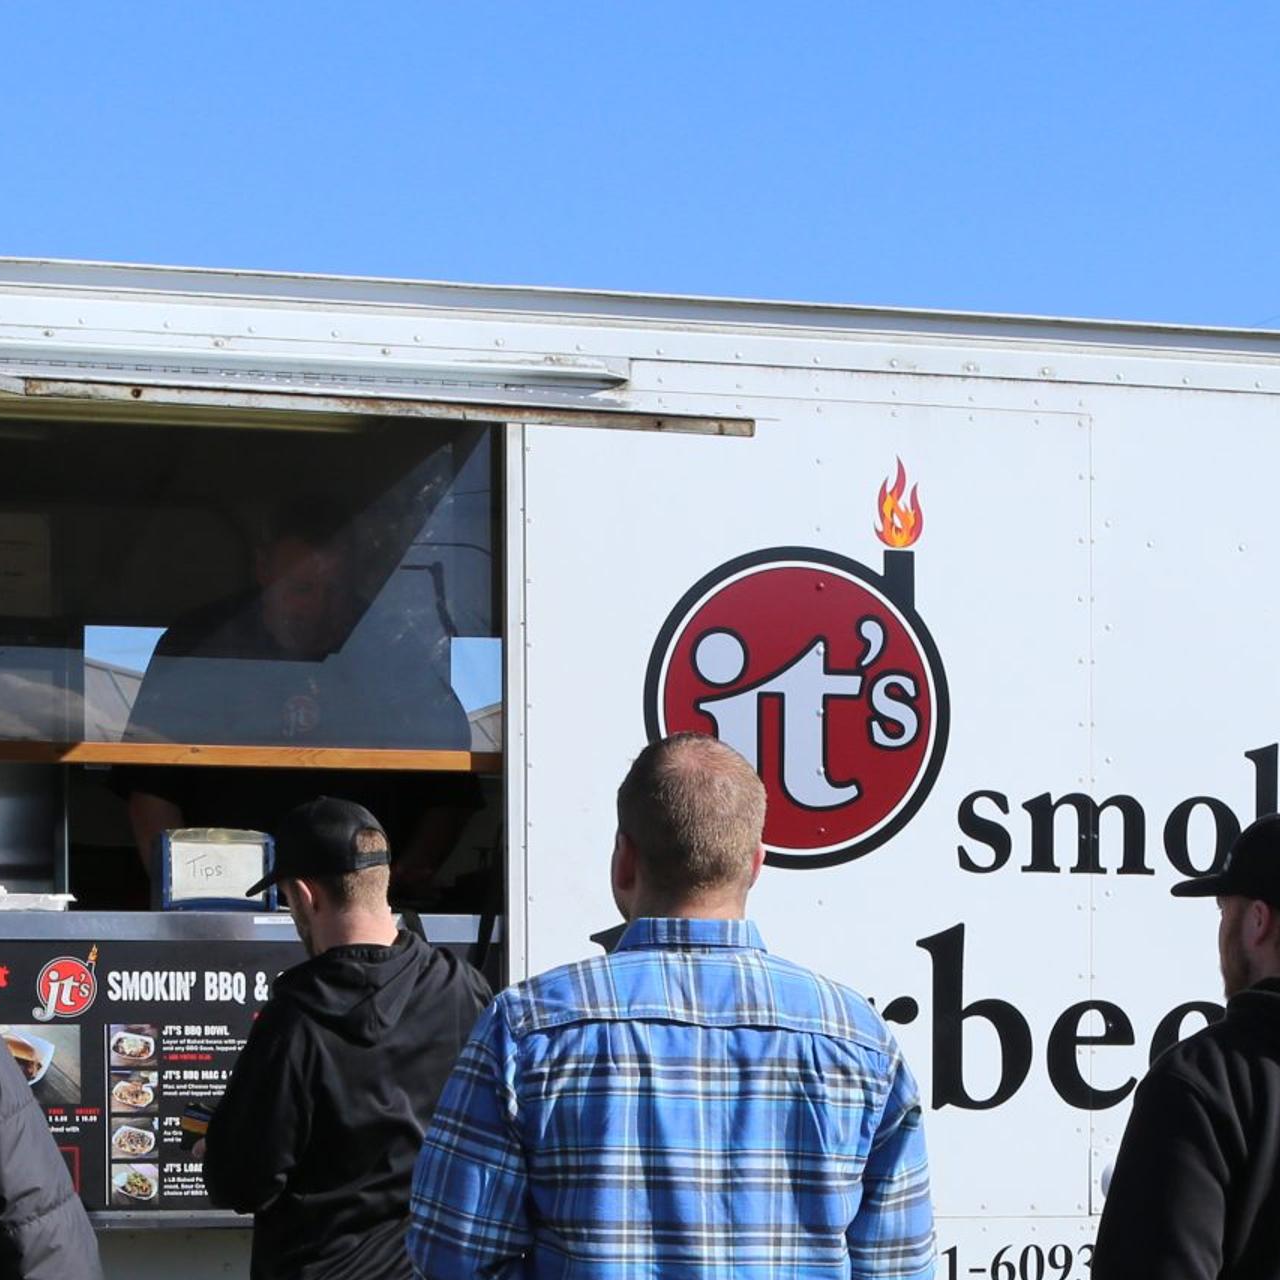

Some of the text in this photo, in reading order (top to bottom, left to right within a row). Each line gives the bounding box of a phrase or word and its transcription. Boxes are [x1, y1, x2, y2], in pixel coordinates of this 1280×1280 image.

[186, 854, 223, 881] Tips
[107, 970, 269, 1005] SMOKIN' BBQ &
[32, 970, 91, 1022] jt's
[162, 1025, 230, 1037] JT'S BBQ BOWL
[162, 1070, 181, 1080] JT'S
[162, 1116, 181, 1126] JT'S
[163, 1163, 182, 1173] JT'S
